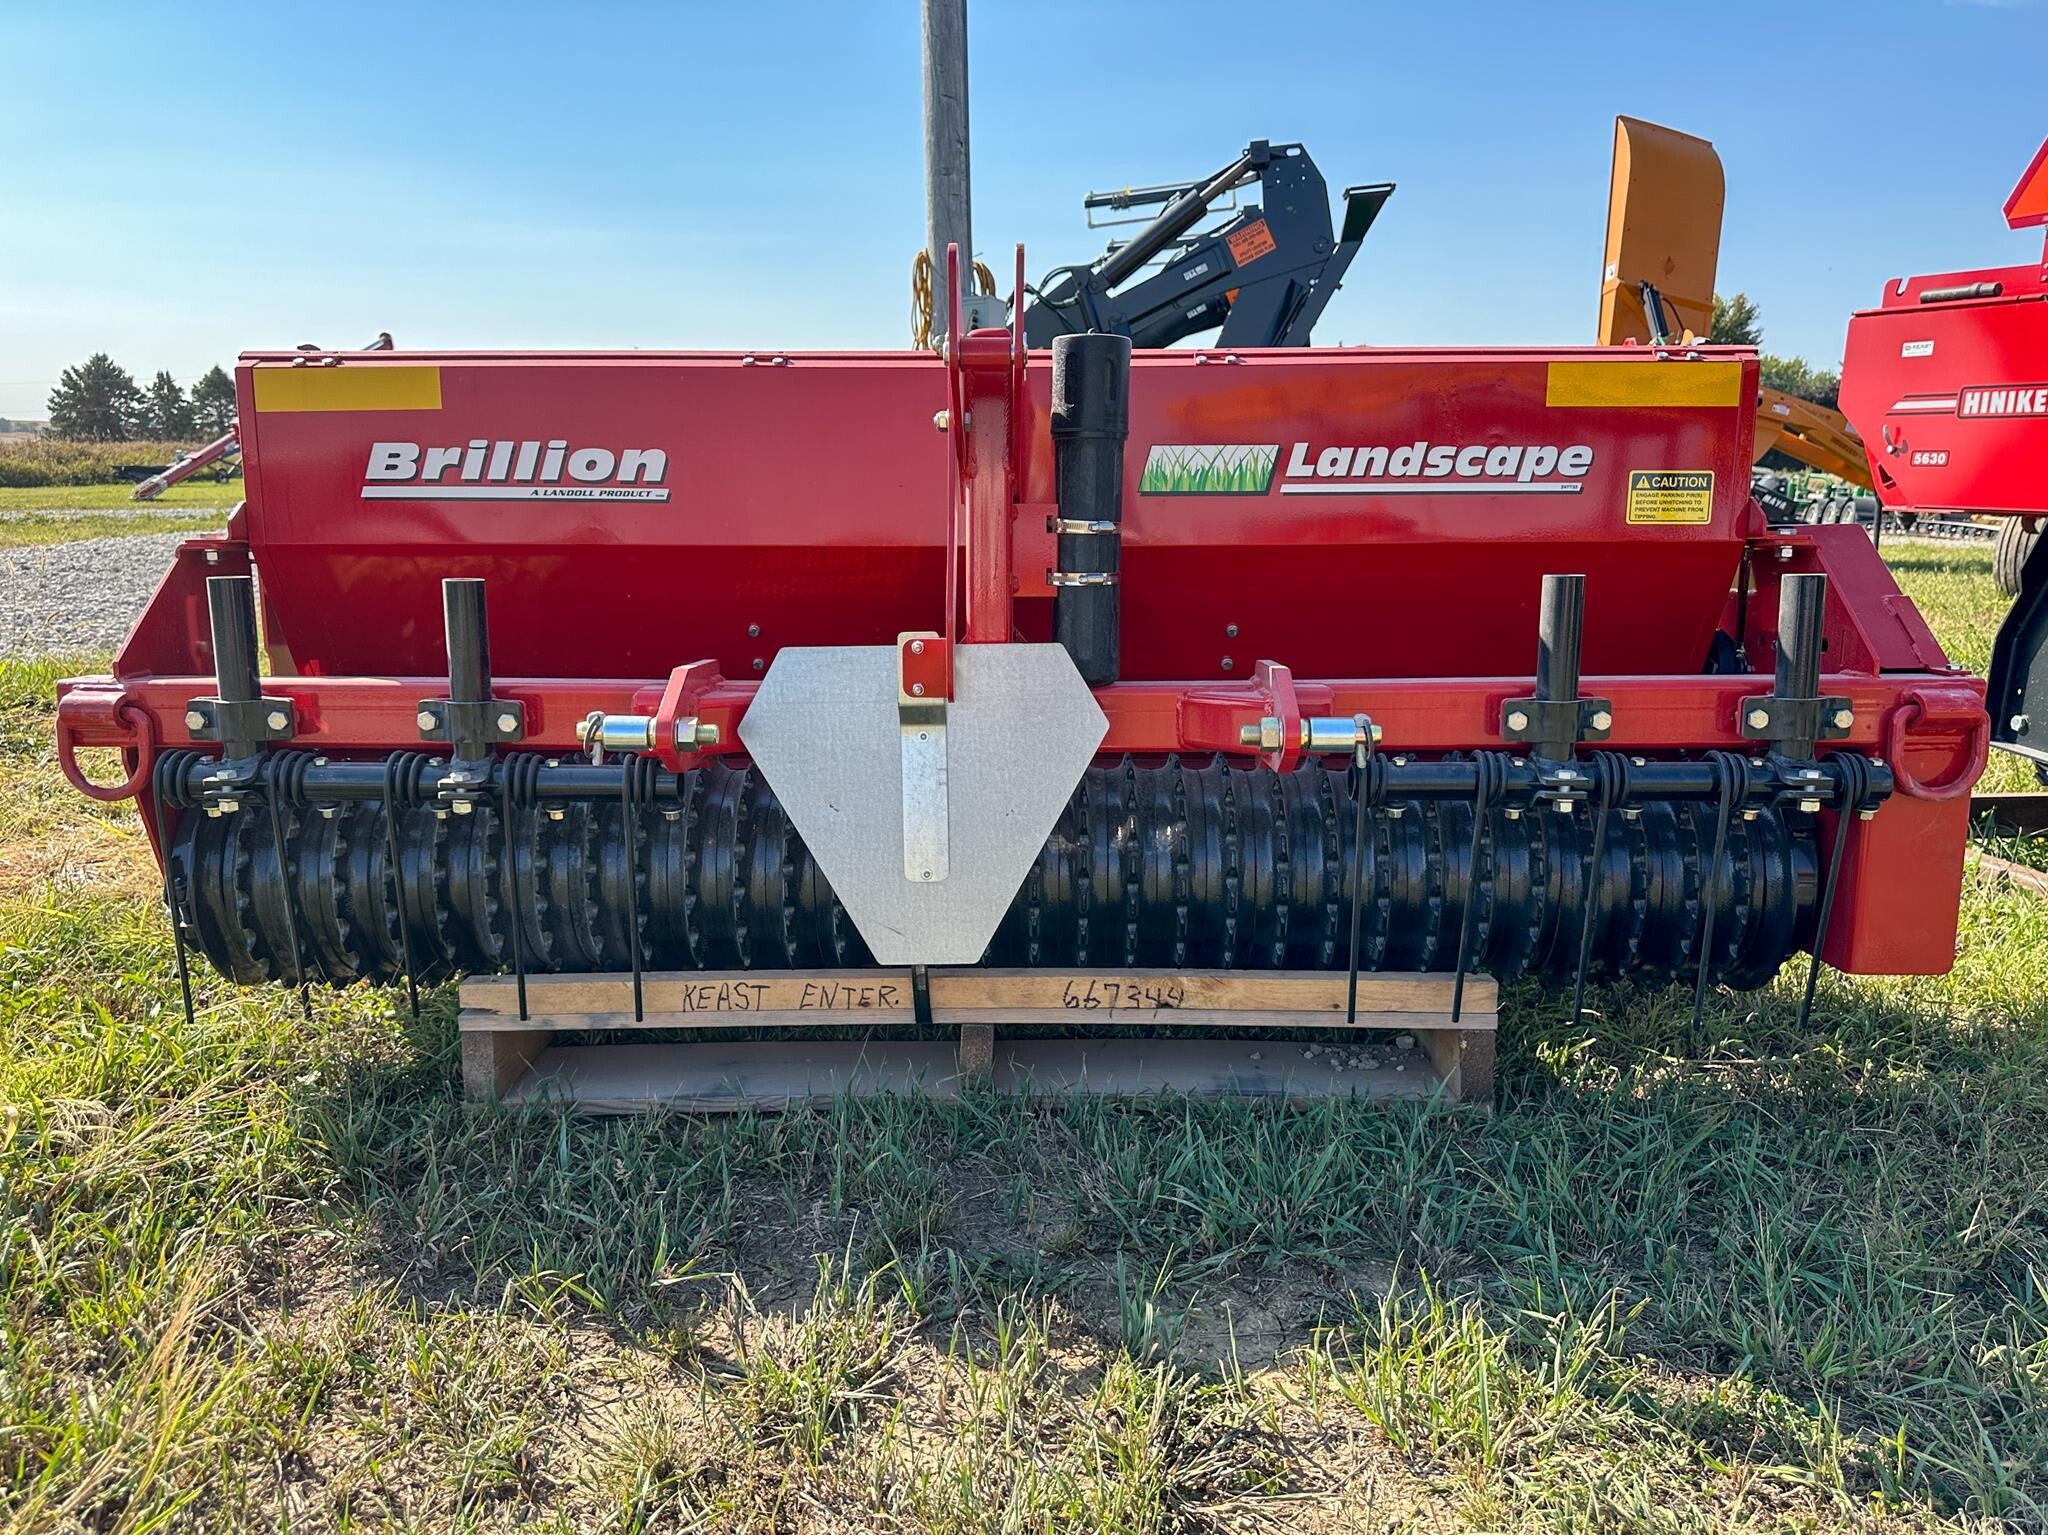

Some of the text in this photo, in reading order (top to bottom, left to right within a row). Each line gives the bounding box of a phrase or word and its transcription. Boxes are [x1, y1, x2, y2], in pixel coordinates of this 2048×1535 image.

[1962, 389, 2048, 415] HINIKE
[364, 438, 668, 484] Brillion
[1284, 441, 1594, 483] Landscape
[1913, 452, 1947, 465] 5630
[543, 489, 595, 497] LANDOLL
[598, 490, 653, 498] PRODUCT
[1651, 476, 1708, 488] CAUTION
[683, 982, 900, 1012] KEAST ENTER.
[1062, 979, 1185, 1020] 667344
